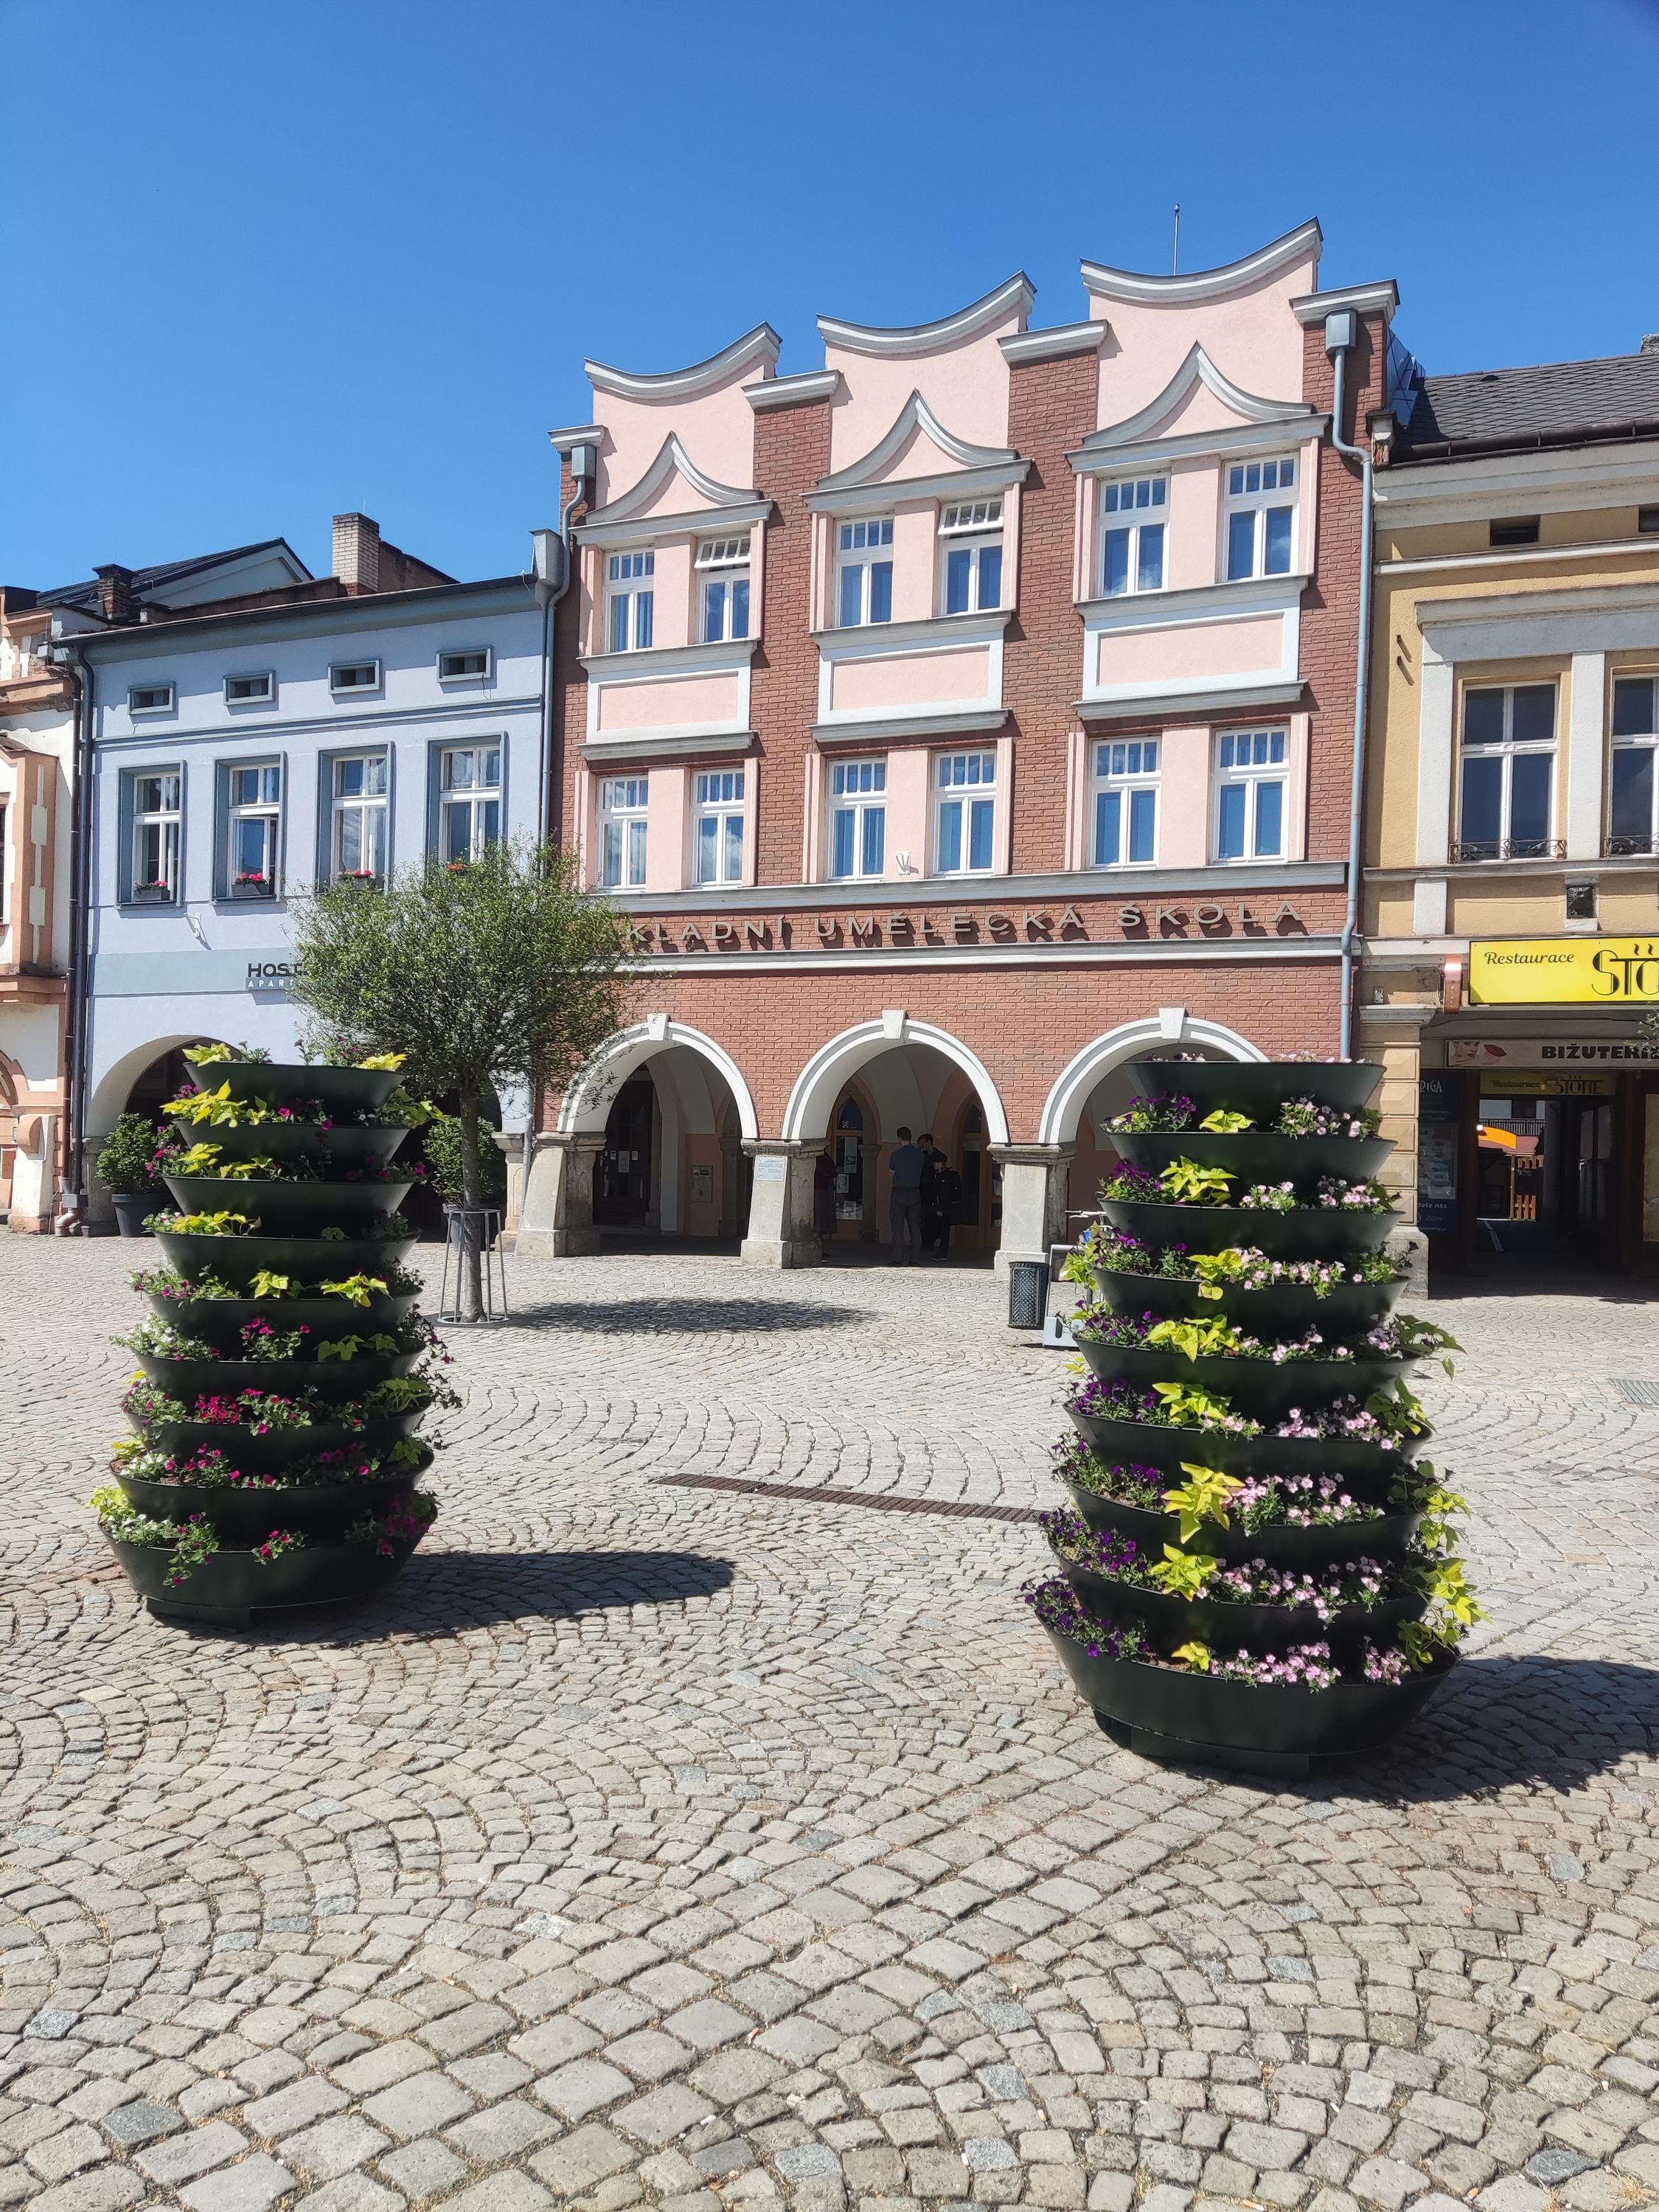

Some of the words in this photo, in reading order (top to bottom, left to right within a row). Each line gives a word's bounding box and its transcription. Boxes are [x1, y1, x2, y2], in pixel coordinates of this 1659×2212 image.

[627, 914, 786, 942] KLADNÍ
[814, 904, 1083, 936] UMĚLECKÁ
[1117, 901, 1301, 927] ŠKOLA
[1484, 951, 1575, 964] Restaurace
[248, 962, 305, 977] HOST
